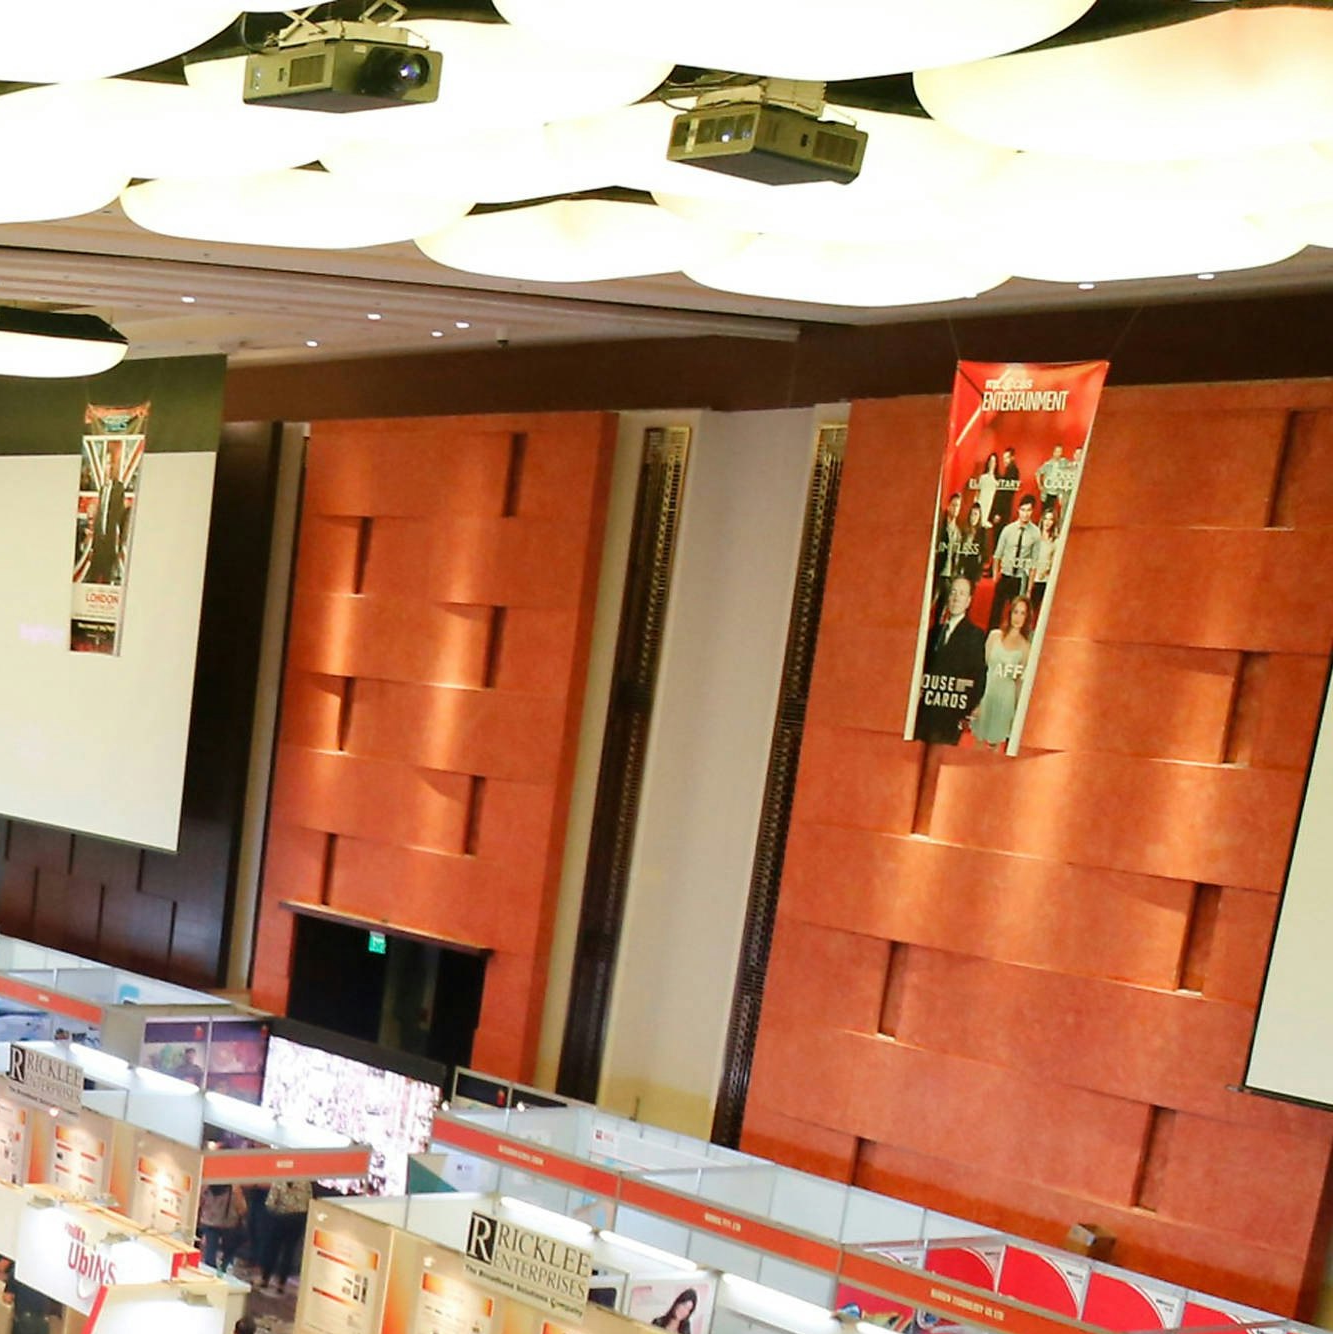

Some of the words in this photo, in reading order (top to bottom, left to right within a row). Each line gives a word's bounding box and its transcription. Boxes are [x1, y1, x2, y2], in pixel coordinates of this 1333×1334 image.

[982, 391, 1069, 411] ENTERTAINMENT
[86, 594, 119, 604] LONDON
[995, 664, 1024, 678] AFF
[923, 674, 956, 691] OUSE
[925, 690, 968, 709] CARDS
[498, 1224, 591, 1279] RICKLEE
[465, 1264, 477, 1274] The
[478, 1270, 515, 1288] Broadband
[493, 1251, 585, 1299] ENTERPRISES
